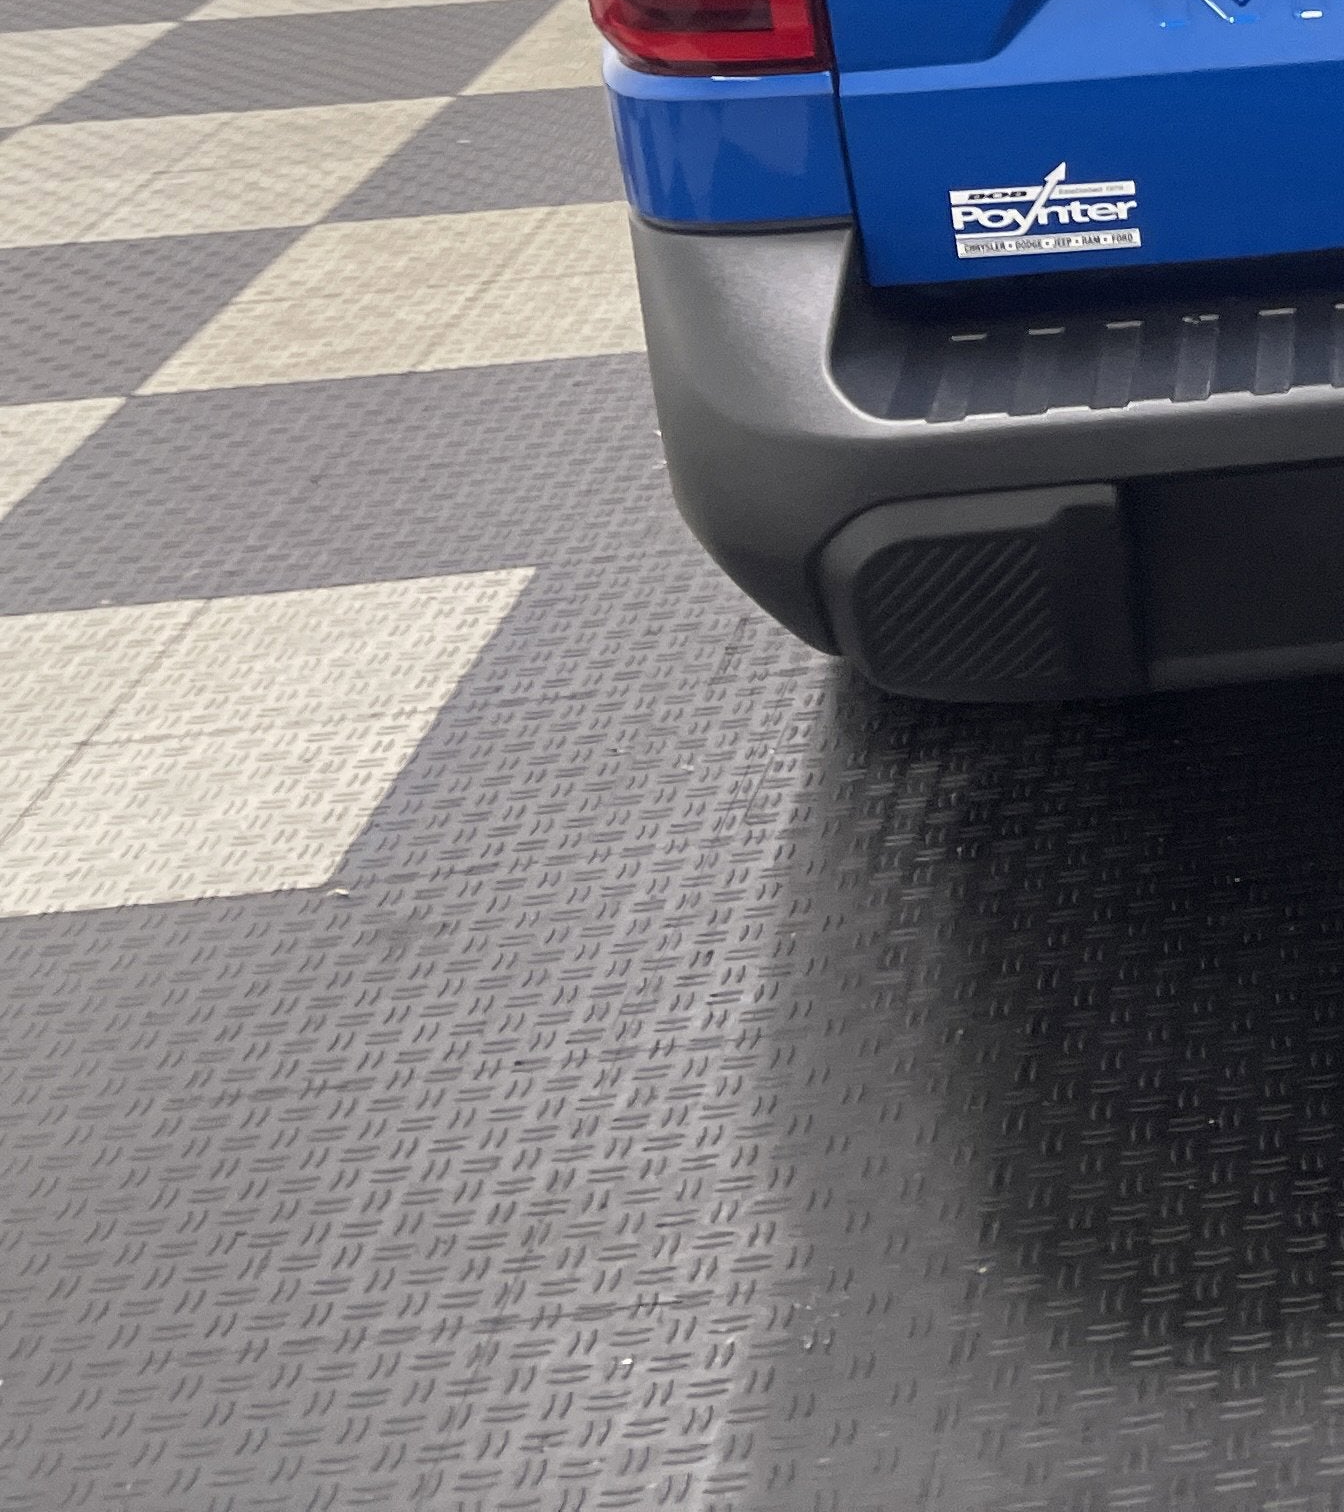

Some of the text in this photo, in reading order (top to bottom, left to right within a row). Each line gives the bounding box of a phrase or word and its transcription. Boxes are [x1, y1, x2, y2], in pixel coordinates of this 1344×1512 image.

[951, 199, 1138, 236] Poynter
[1081, 235, 1101, 245] RAM
[1111, 233, 1134, 243] FORD
